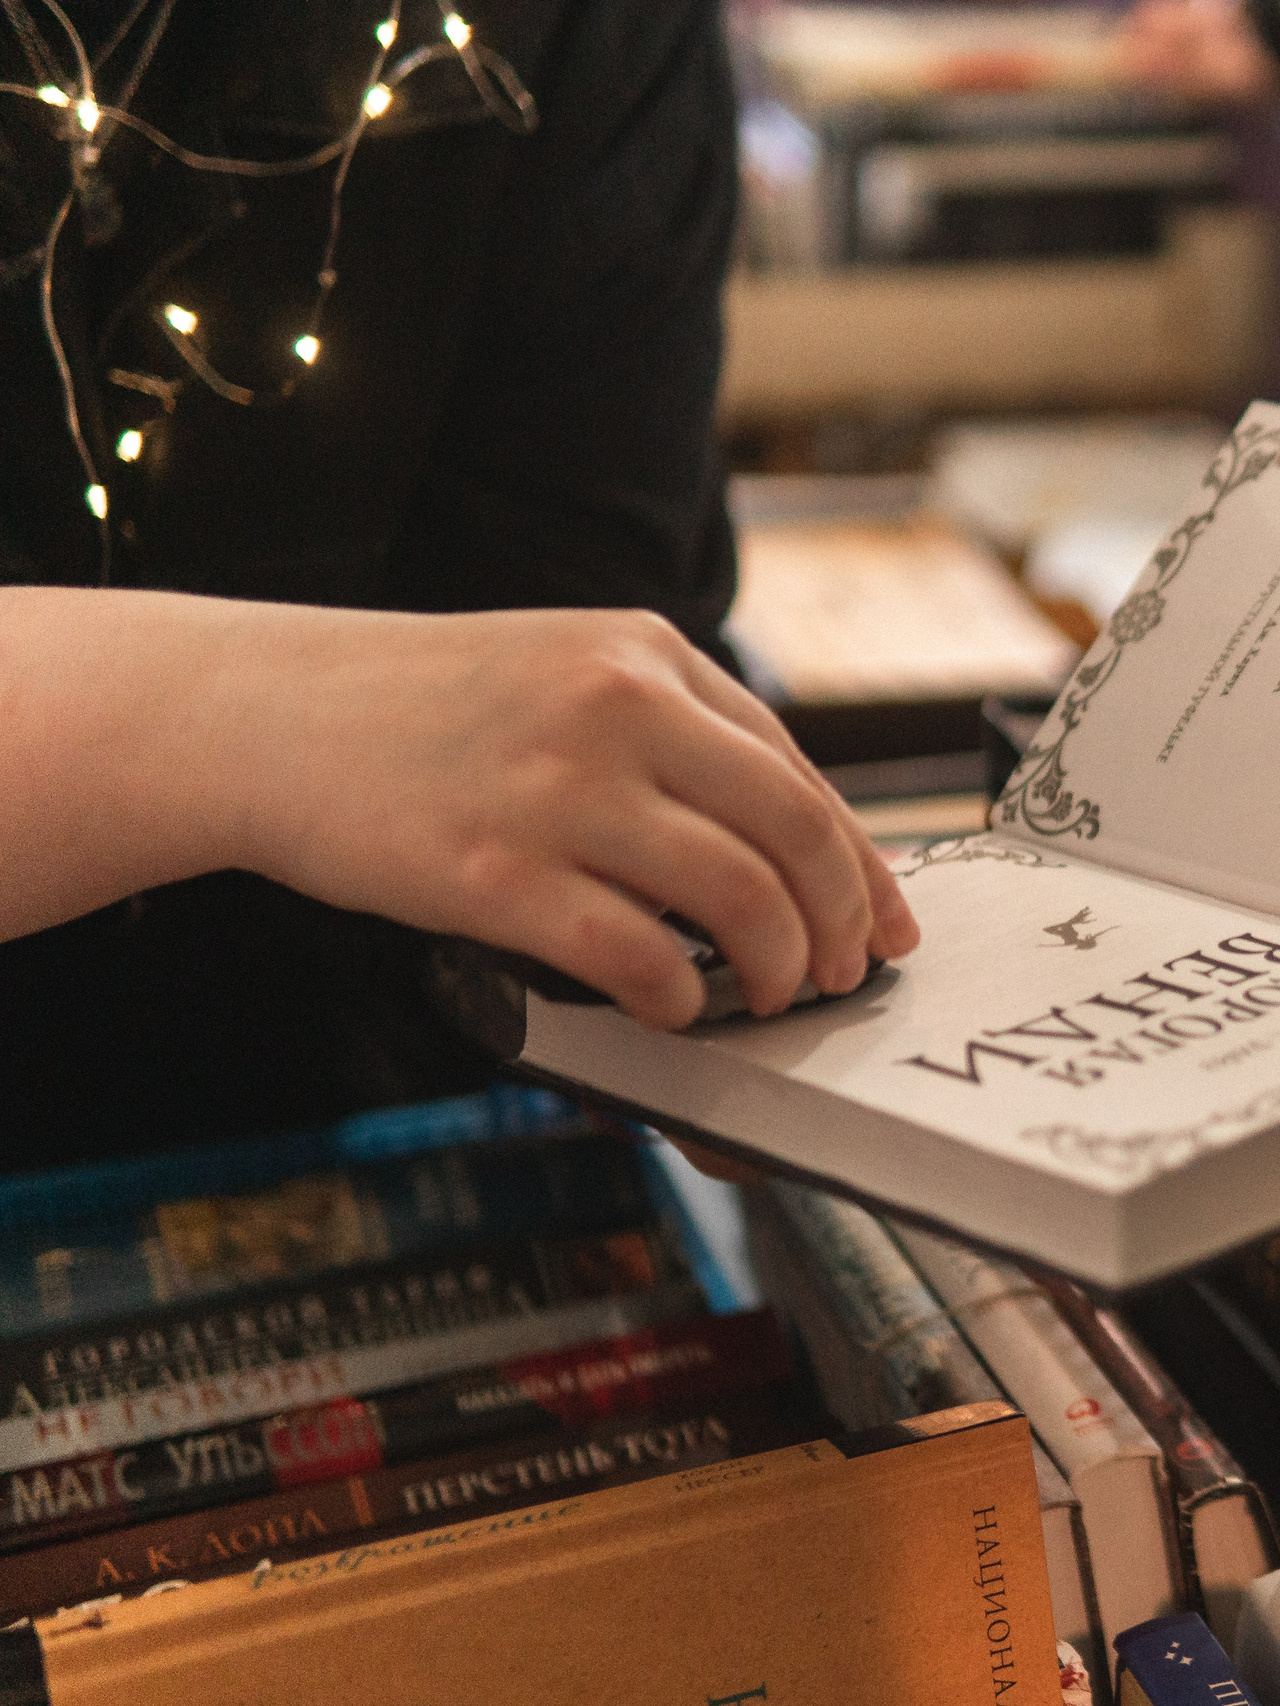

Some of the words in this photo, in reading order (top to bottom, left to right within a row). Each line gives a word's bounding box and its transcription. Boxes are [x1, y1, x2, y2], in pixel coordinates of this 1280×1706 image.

[10, 1452, 146, 1525] МАТС
[165, 1399, 389, 1490] УЛЬССОН
[402, 1440, 617, 1515] ПЕРСТЕНЬ
[973, 1505, 1018, 1706] НАЦИОНА
